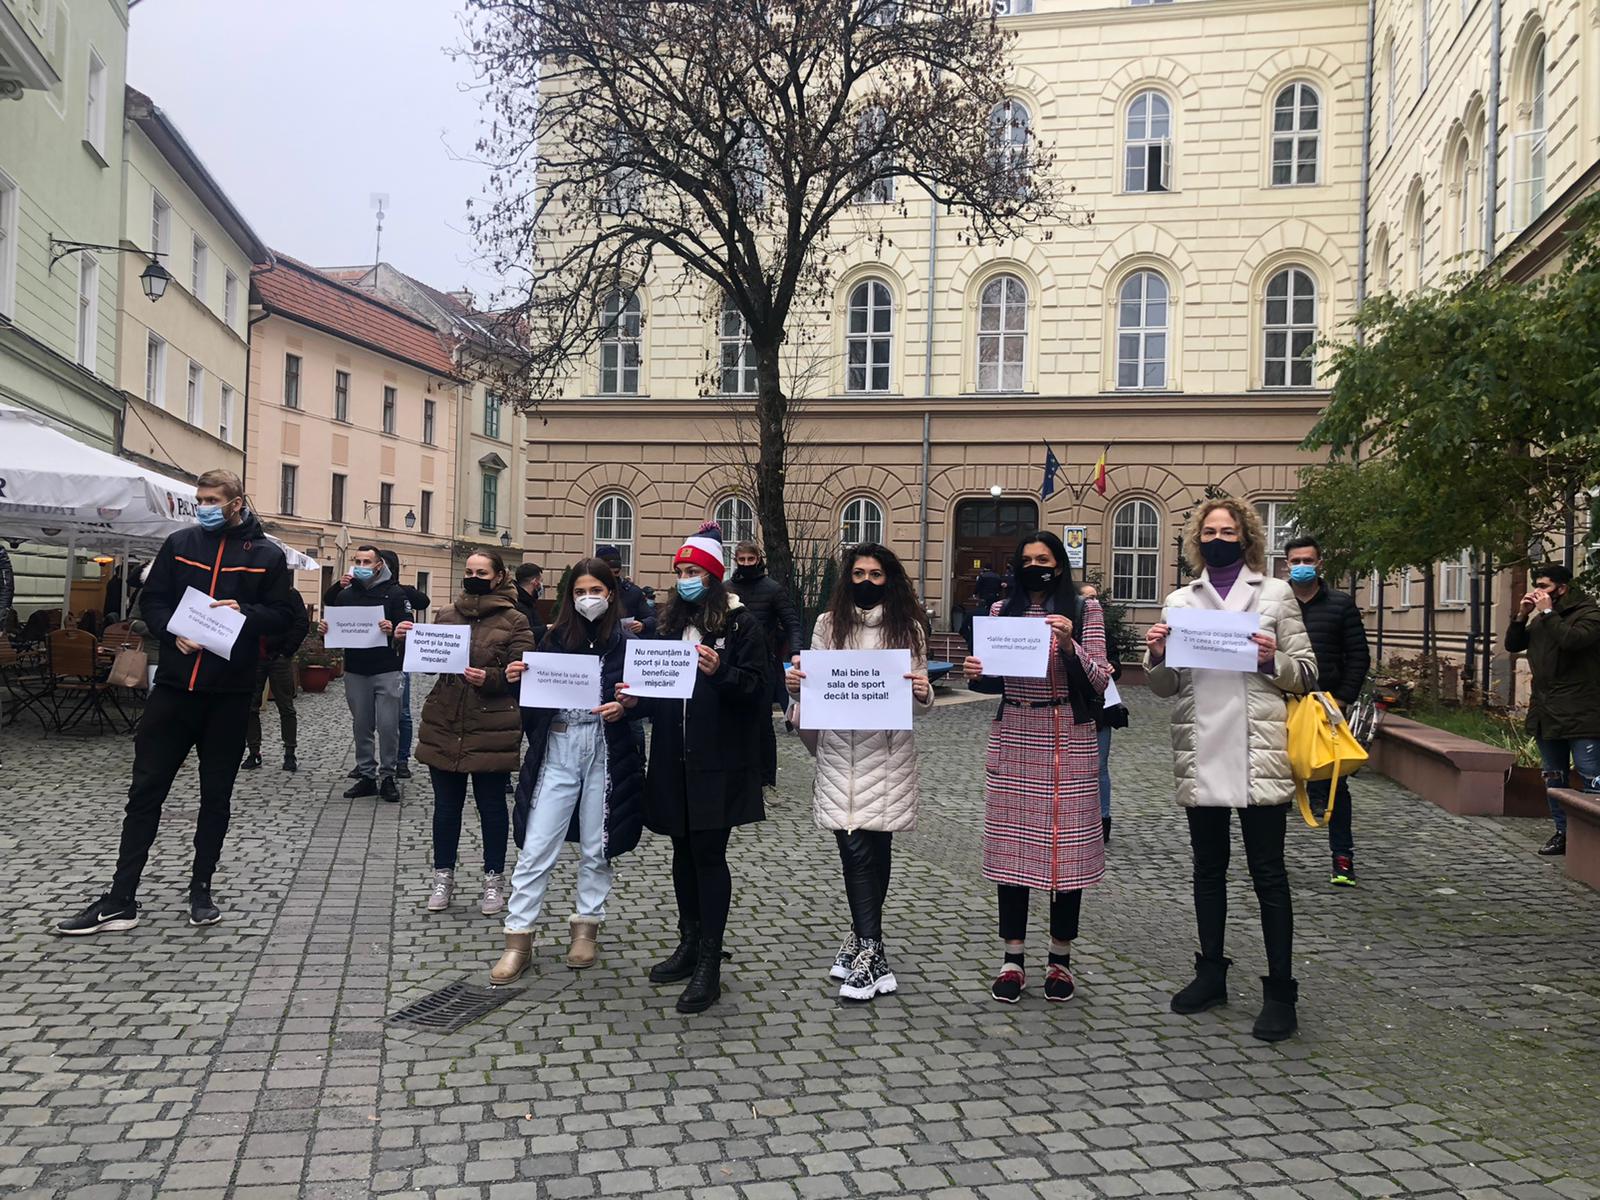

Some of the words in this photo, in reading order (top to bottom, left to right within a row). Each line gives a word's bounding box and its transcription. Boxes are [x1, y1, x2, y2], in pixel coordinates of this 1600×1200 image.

[425, 631, 454, 639] renunțăm
[444, 640, 460, 648] toate
[420, 647, 451, 655] beneficiile
[634, 648, 645, 656] Nu
[647, 648, 682, 658] renunțăm
[633, 659, 653, 667] sport
[671, 659, 690, 667] toate
[641, 669, 680, 677] beneficiile
[831, 668, 848, 677] Mai
[850, 668, 870, 677] bine
[872, 668, 880, 677] la
[644, 680, 676, 688] mișcării!
[827, 680, 845, 688] sala
[847, 680, 859, 688] de
[861, 680, 885, 690] sport
[824, 692, 849, 700] decât
[851, 692, 859, 700] la
[861, 692, 889, 701] spital!
